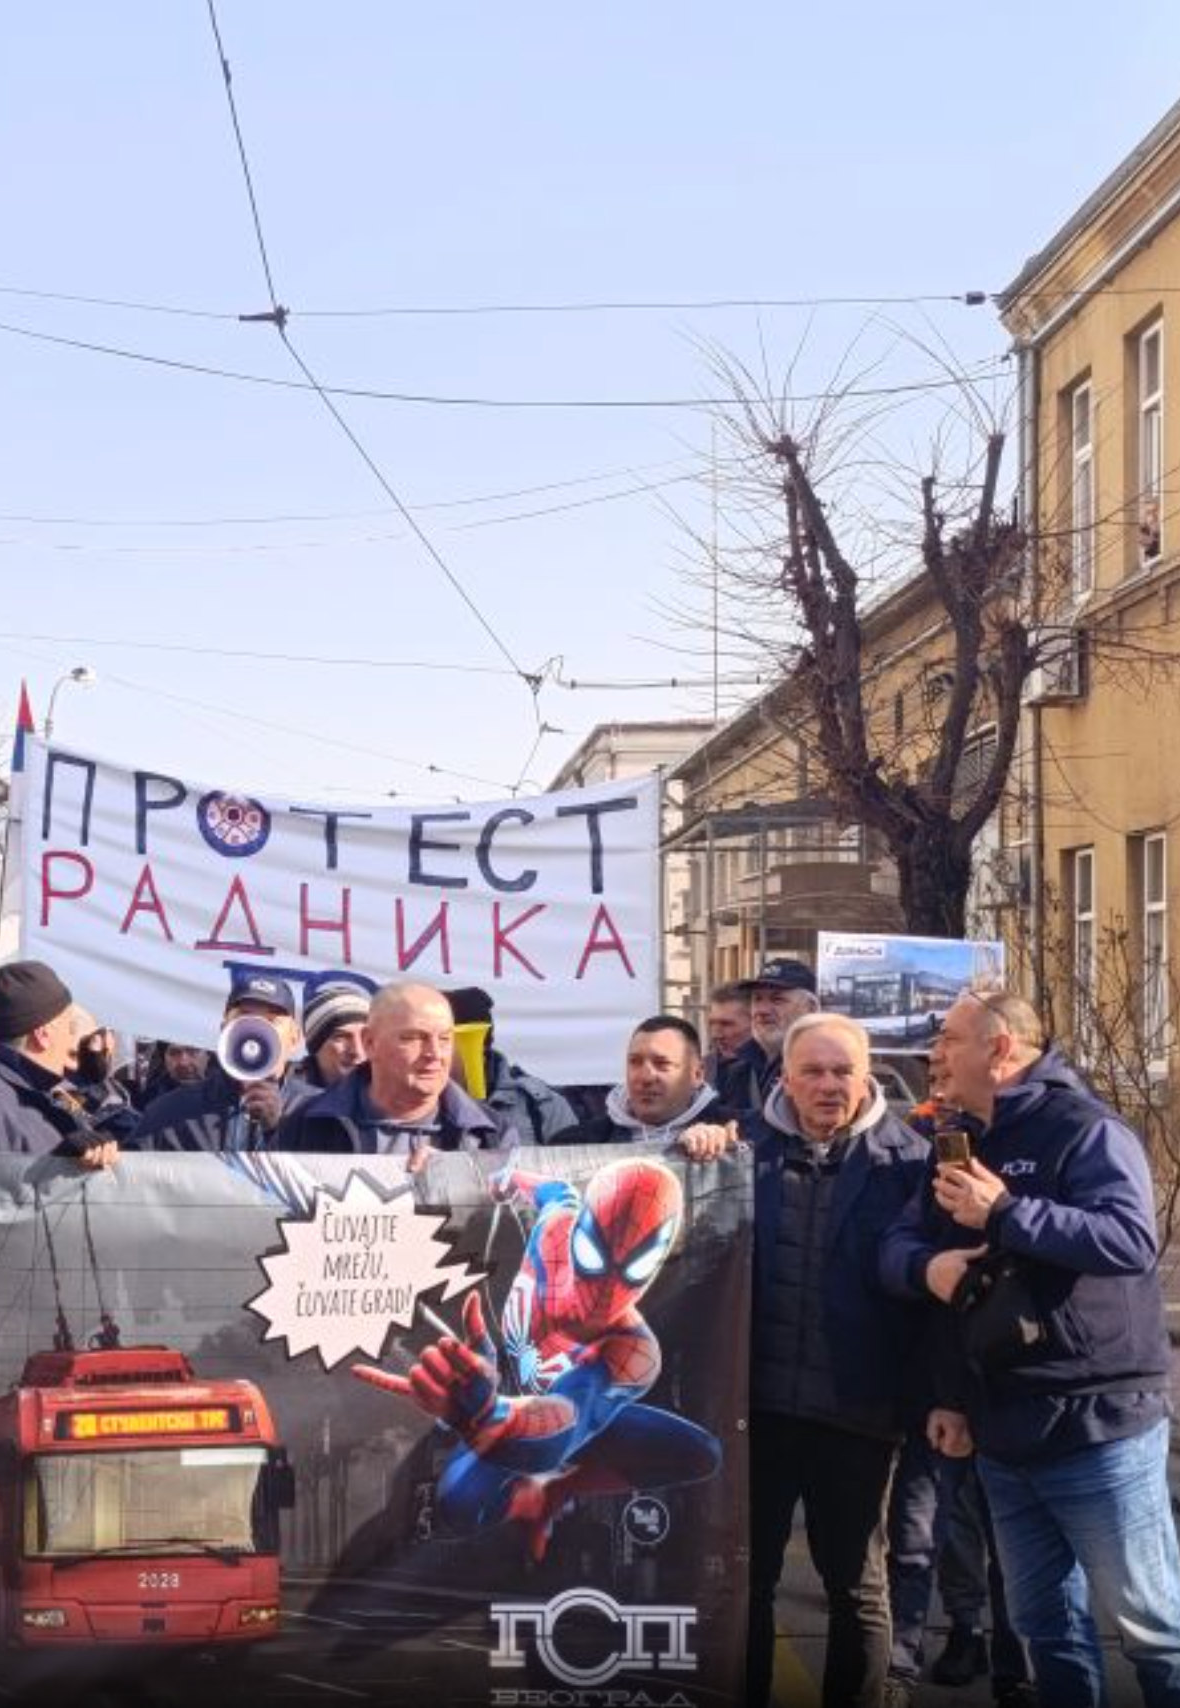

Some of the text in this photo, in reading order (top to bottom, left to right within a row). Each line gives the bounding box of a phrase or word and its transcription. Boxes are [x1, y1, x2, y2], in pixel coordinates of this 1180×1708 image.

[39, 851, 635, 980] РАДНИКА
[322, 1201, 399, 1247] ČUVAJTE
[322, 1244, 389, 1281] MREŽU,
[296, 1281, 413, 1317] ČUVATE GRAD!
